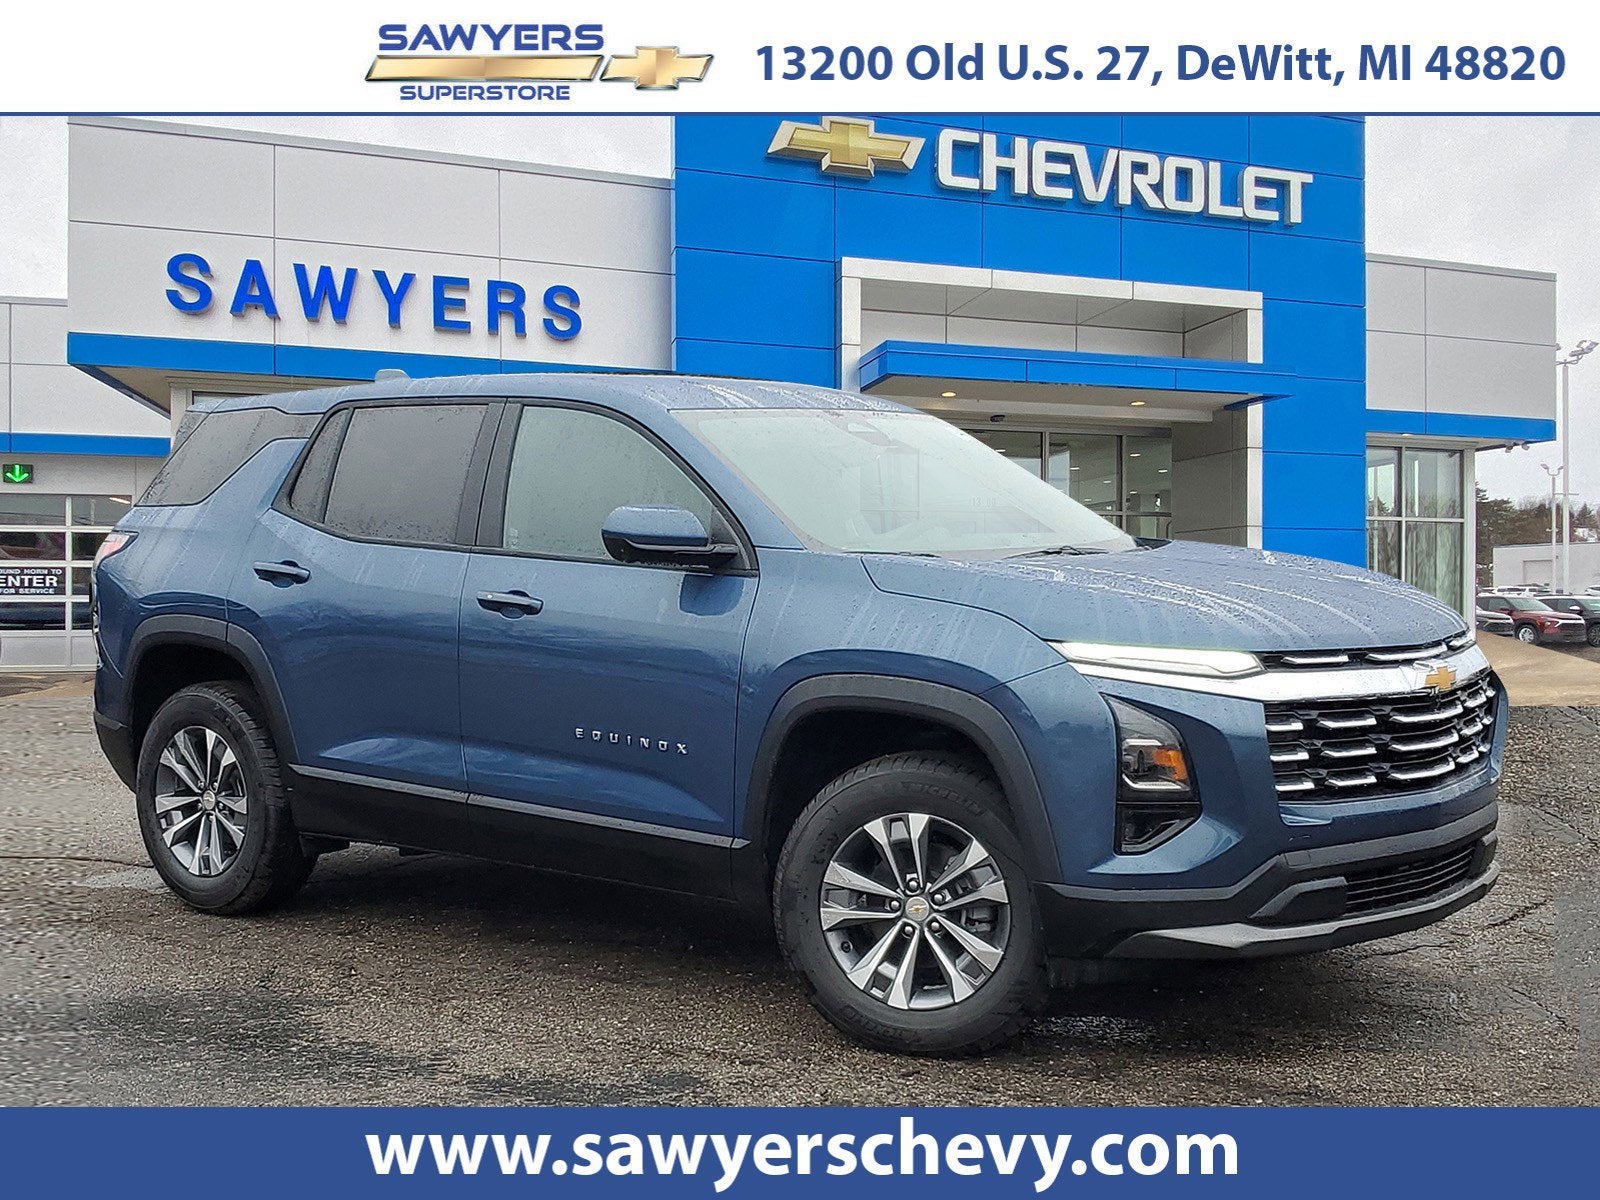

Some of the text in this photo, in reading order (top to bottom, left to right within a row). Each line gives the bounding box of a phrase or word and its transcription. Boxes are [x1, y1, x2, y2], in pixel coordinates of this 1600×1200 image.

[936, 128, 1313, 225] CHEVROLET
[166, 253, 582, 341] SAWYERS
[575, 728, 687, 754] EQUINOX
